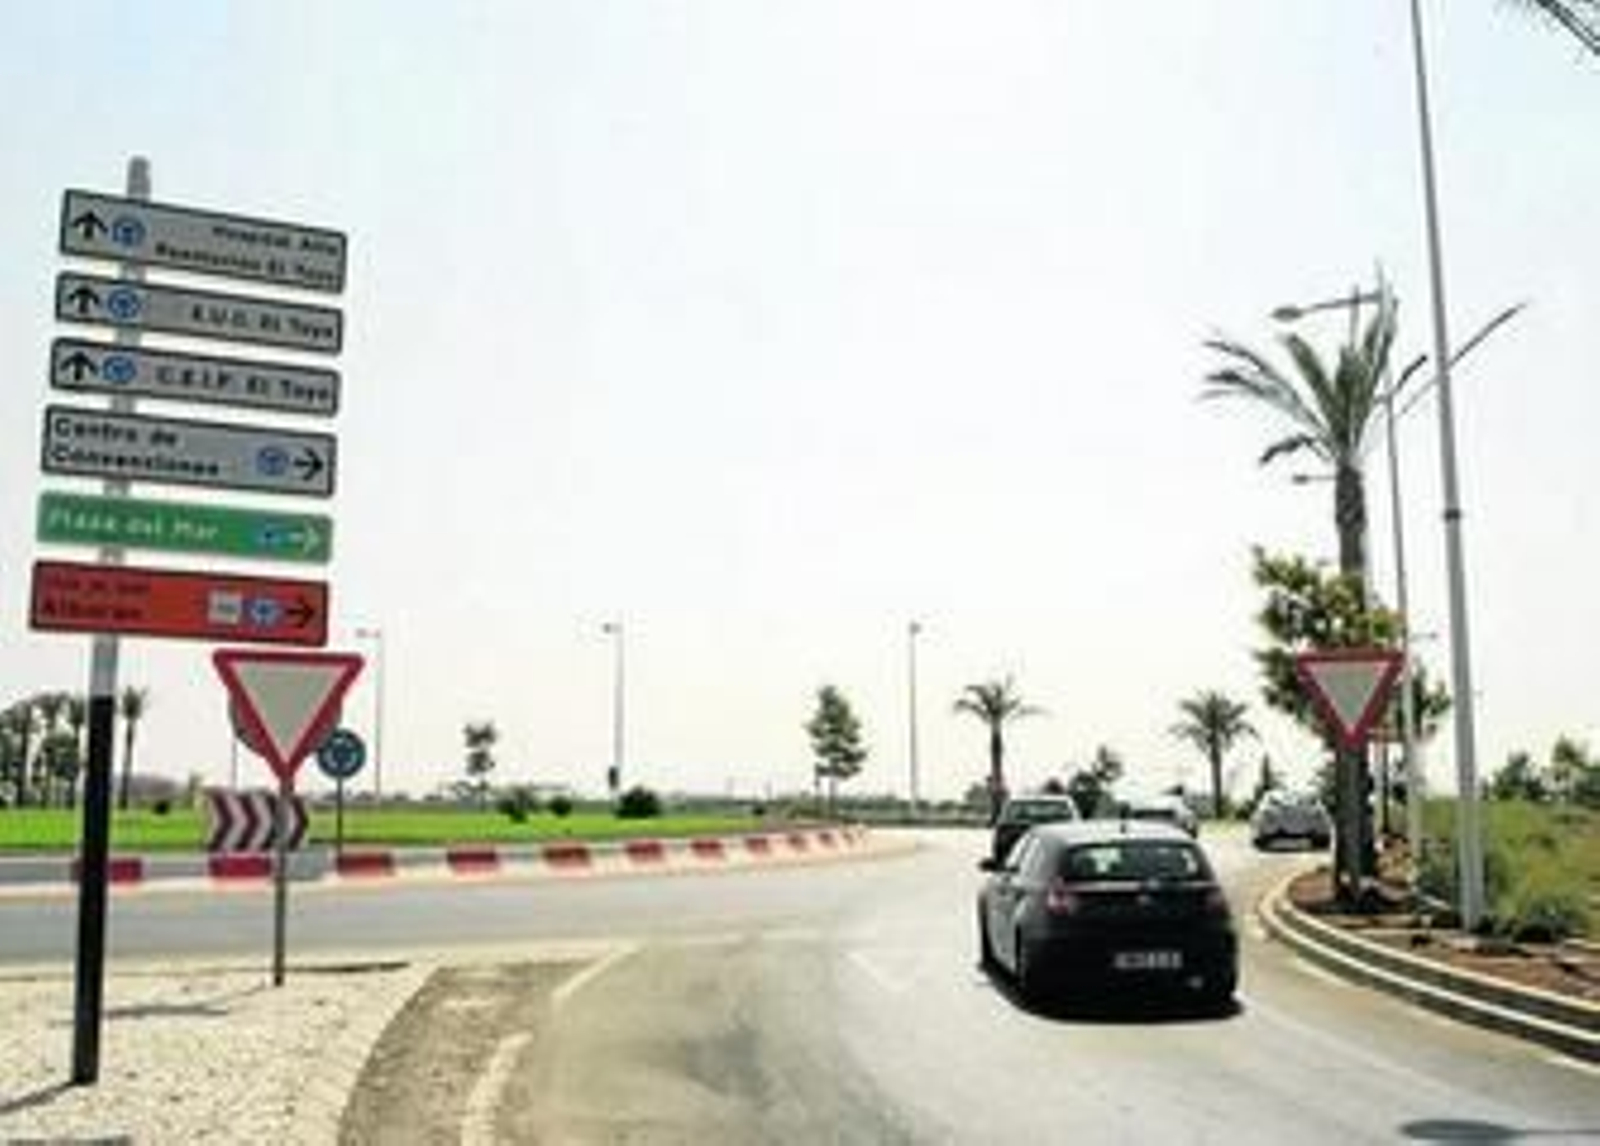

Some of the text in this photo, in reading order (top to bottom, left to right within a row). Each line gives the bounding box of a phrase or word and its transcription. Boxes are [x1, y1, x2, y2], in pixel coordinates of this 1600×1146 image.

[55, 417, 178, 446] Centro de
[174, 515, 219, 540] Mar
